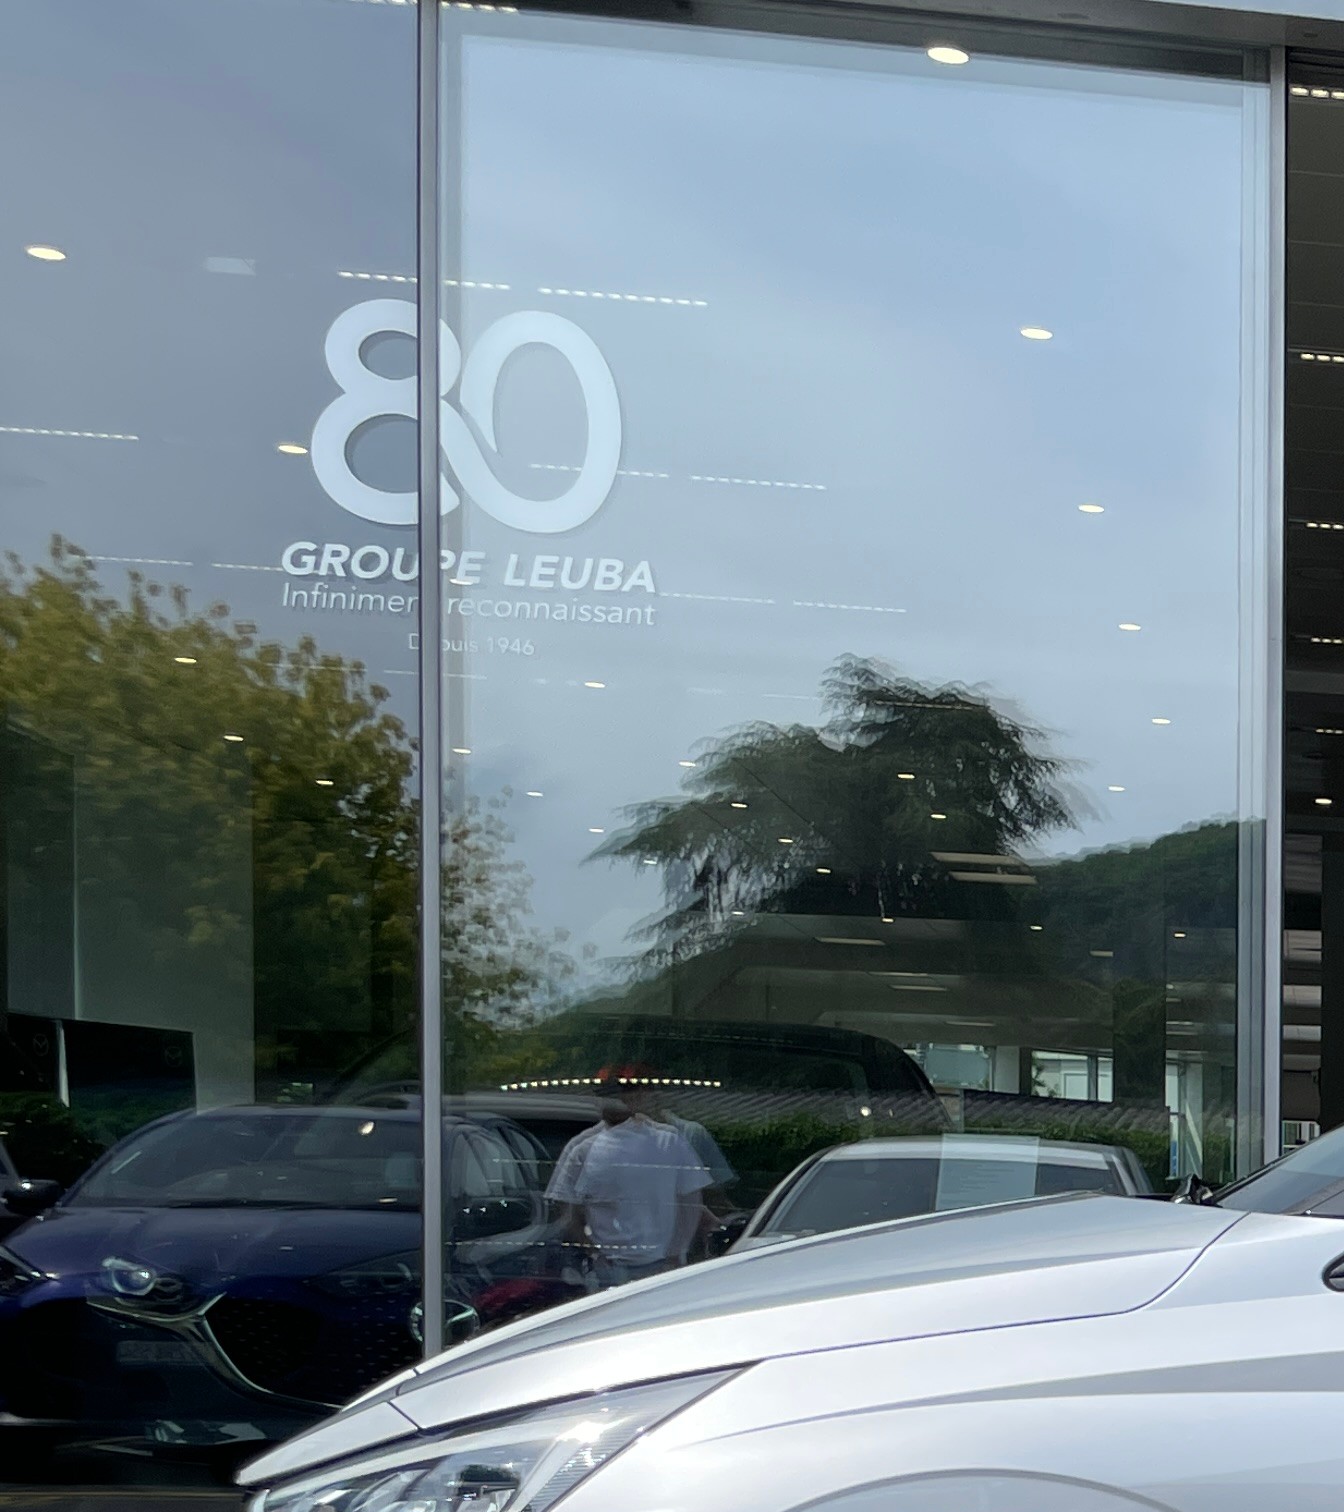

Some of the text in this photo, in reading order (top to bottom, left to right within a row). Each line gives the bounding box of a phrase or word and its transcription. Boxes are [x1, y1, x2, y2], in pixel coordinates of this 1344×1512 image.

[311, 298, 622, 534] 80
[503, 553, 656, 593] LEUBA
[282, 582, 656, 626] Infinimen reconnaissant
[408, 632, 536, 656] Duis 1946
